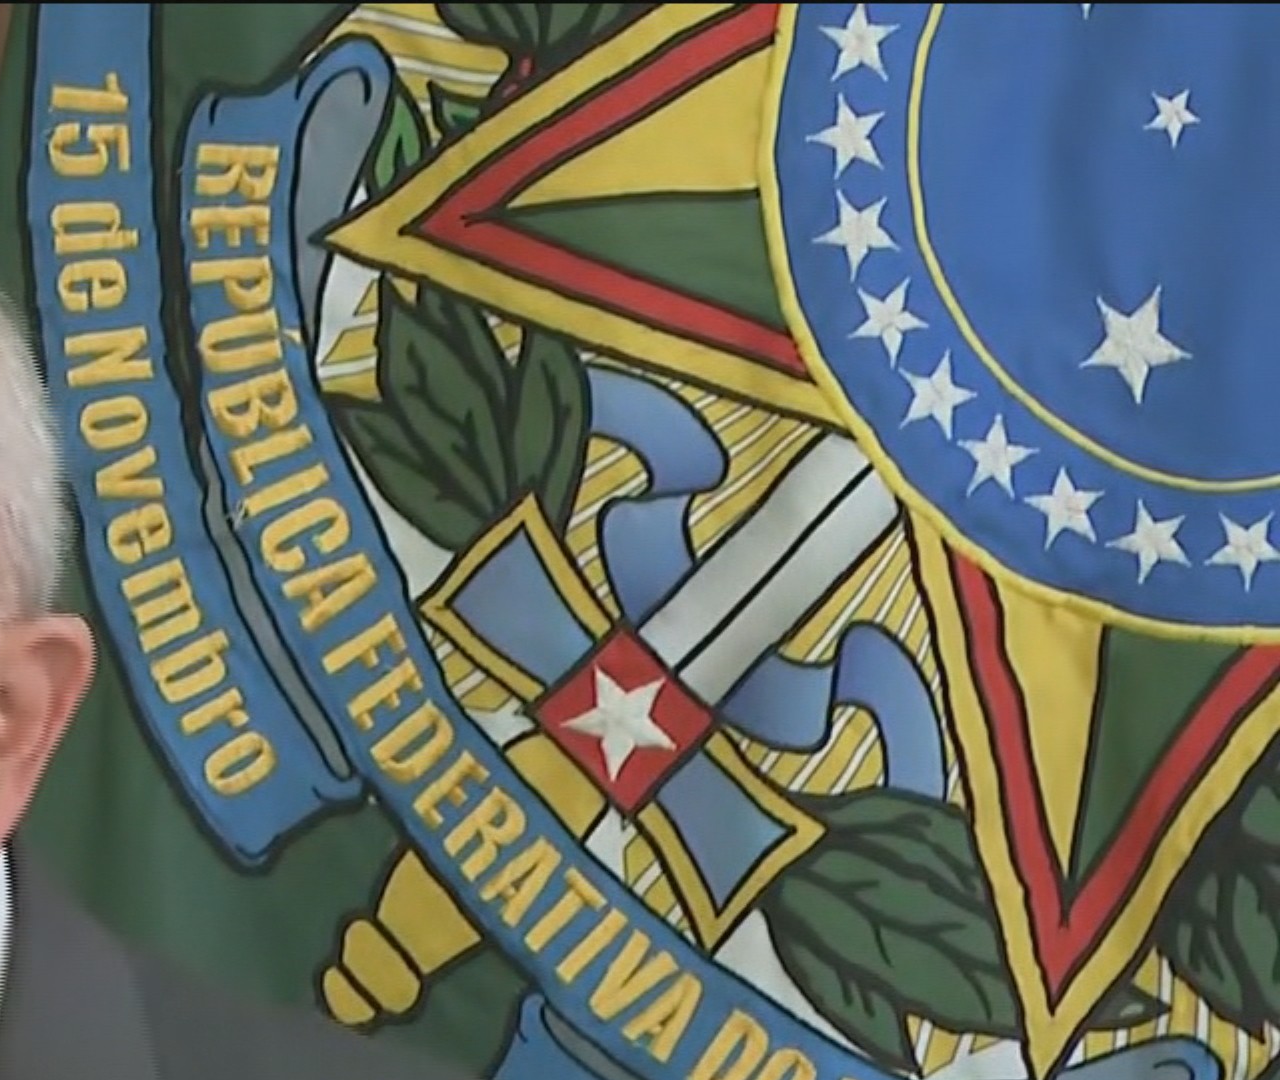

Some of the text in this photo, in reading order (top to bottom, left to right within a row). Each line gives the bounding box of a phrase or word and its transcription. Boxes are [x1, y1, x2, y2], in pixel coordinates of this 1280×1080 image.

[46, 72, 278, 796] 15 de Novembro
[189, 141, 378, 632] REPÚBLICA
[321, 617, 705, 1064] FEDERATIVA
